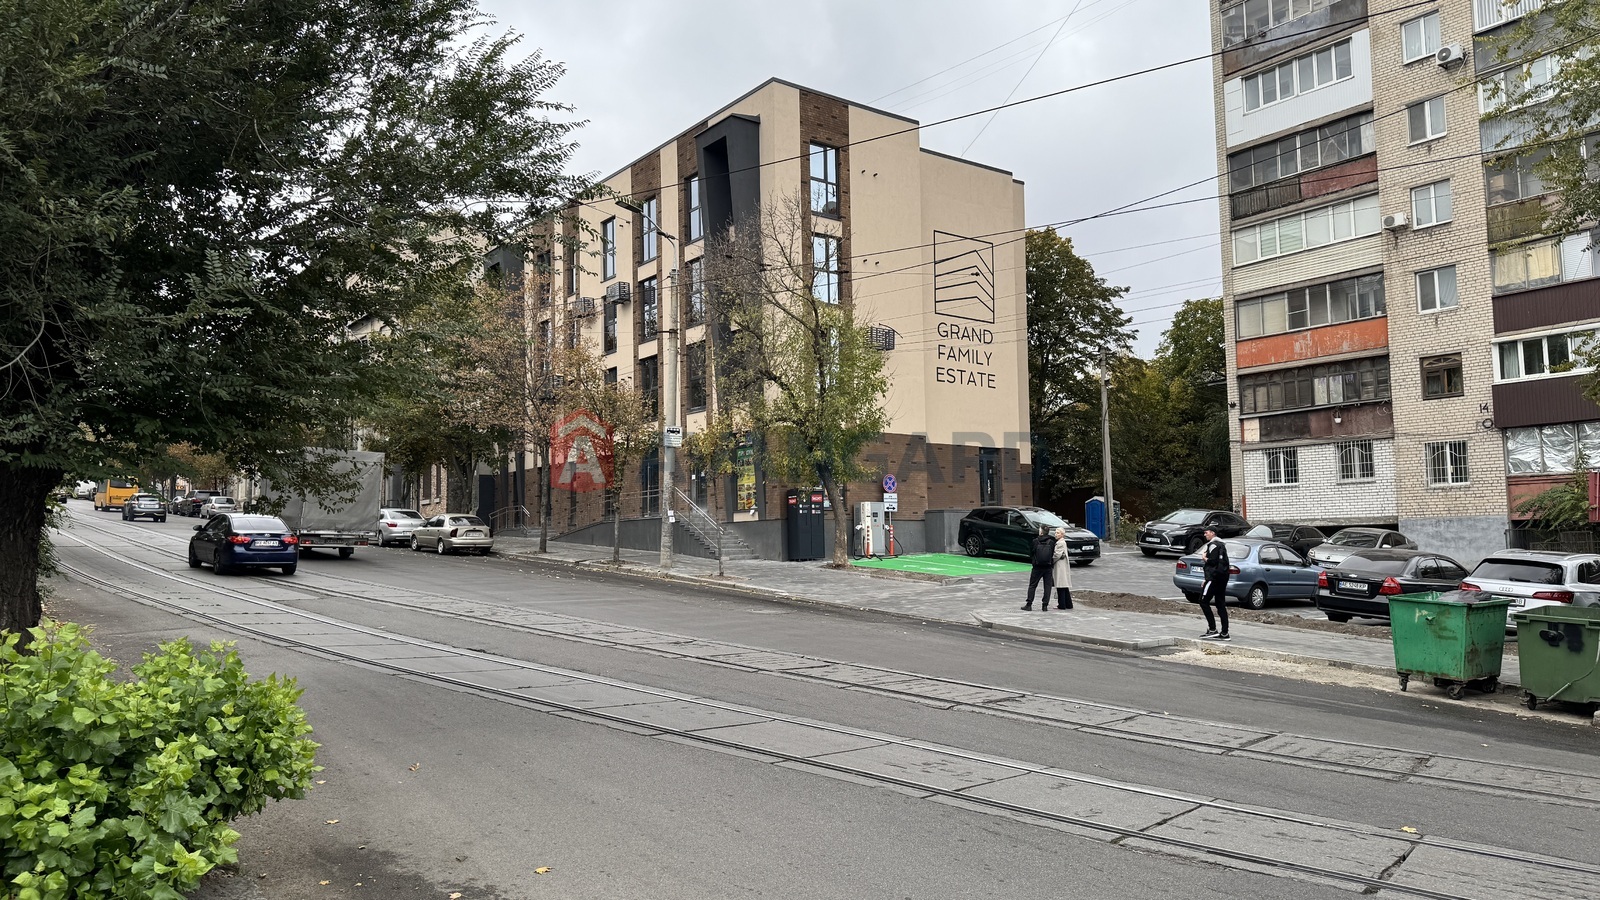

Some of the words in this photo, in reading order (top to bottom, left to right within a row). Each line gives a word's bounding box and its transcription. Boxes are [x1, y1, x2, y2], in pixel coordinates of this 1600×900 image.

[937, 322, 994, 344] GRAND
[937, 344, 993, 366] FAMILY
[936, 366, 996, 389] ESTATE
[1479, 402, 1489, 413] 14
